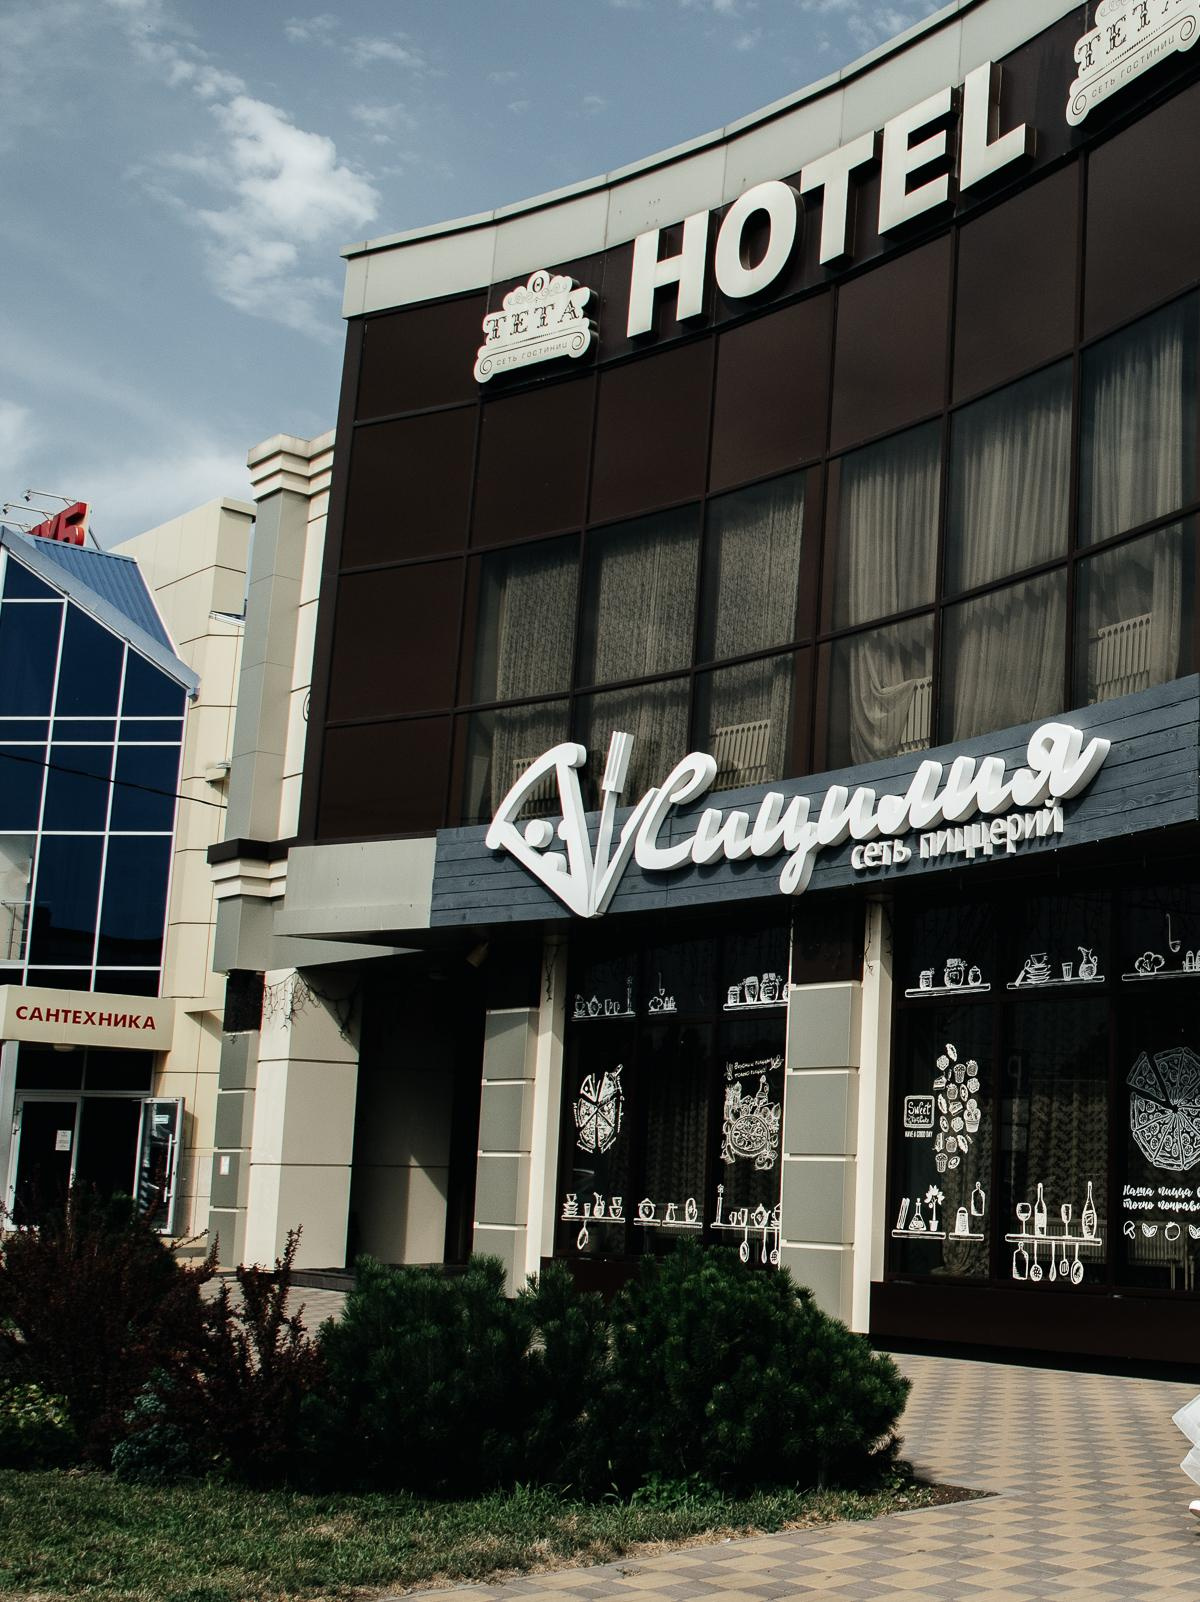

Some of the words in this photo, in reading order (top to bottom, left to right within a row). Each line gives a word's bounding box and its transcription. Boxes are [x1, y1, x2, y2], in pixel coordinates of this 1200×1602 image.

[1077, 0, 1186, 71] ТЕТ
[1091, 77, 1116, 98] СЕТЬ
[1120, 35, 1176, 78] ГОСТИНИЦ
[626, 60, 1035, 340] HOTEL
[485, 299, 580, 341] ТЕТА
[495, 356, 518, 367] СЕТЬ
[520, 342, 569, 359] ГОСТИНИЦ
[635, 721, 1112, 897] Сицилия
[850, 838, 912, 871] сеть
[919, 796, 1065, 860] пиццерий
[15, 1005, 156, 1030] САНТЕХНИКА
[1122, 1184, 1155, 1197] Наша
[1157, 1186, 1194, 1199] пицца
[1122, 1198, 1155, 1210] точно
